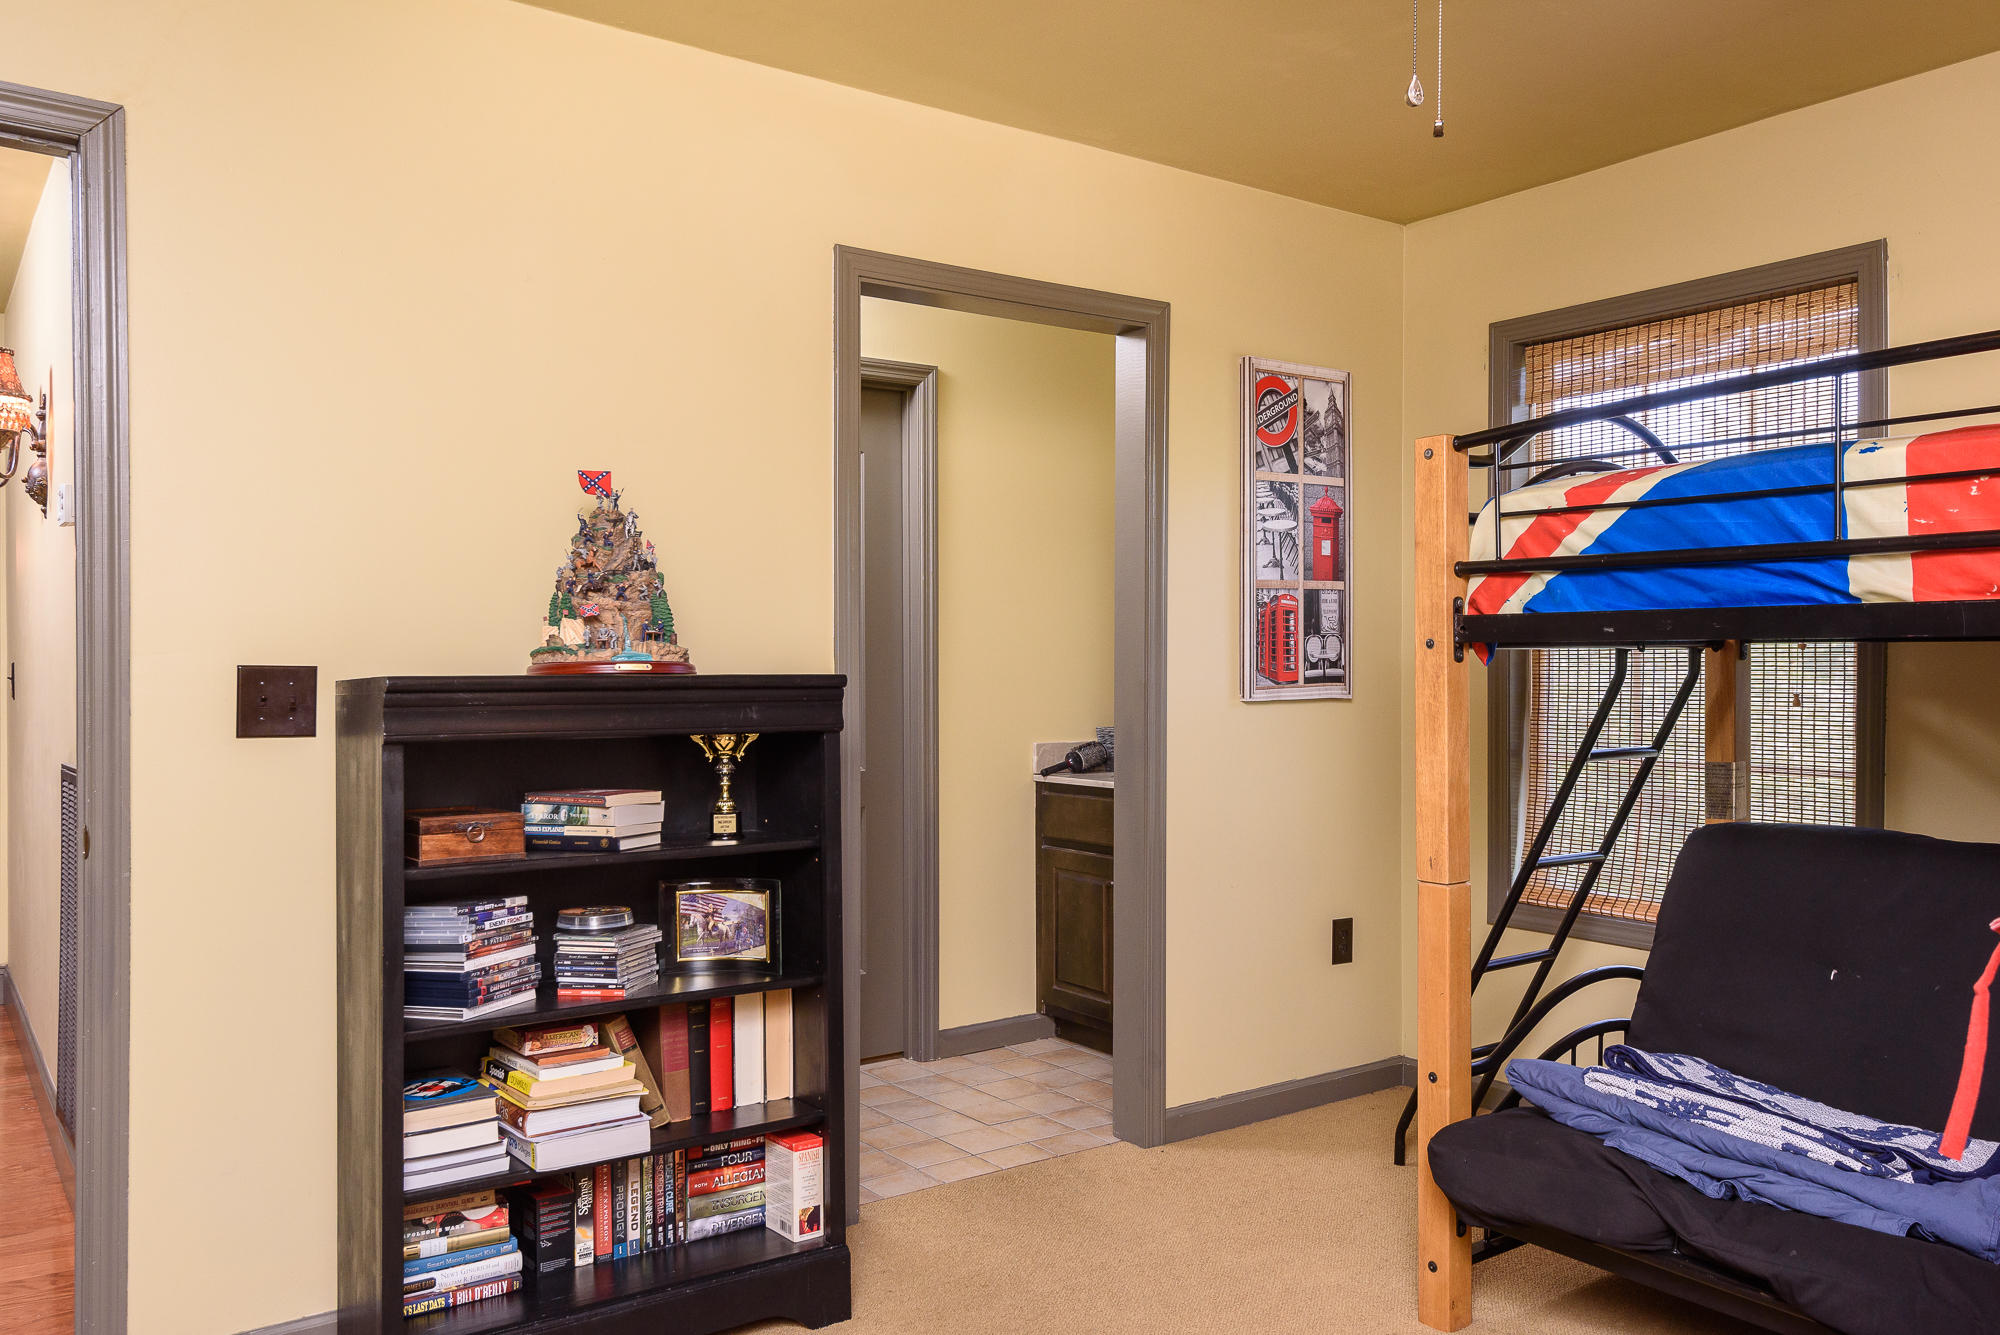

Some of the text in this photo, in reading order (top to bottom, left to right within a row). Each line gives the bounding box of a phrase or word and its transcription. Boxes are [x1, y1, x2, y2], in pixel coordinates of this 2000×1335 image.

[489, 919, 506, 928] ENEMY
[507, 915, 522, 924] FRONT
[489, 1064, 505, 1080] Spanish
[710, 1142, 729, 1152] ONLY
[730, 1138, 752, 1148] THING
[721, 1151, 753, 1167] FOUR
[798, 1149, 820, 1163] SPANISH
[656, 1164, 664, 1195] SCORCH
[675, 1162, 684, 1183] KILL
[578, 1177, 592, 1216] Spanish
[665, 1163, 674, 1215] DEATH CURE
[616, 1185, 624, 1238] PRODIGY
[630, 1180, 638, 1231] LEGEND
[644, 1191, 653, 1227] RUNNER
[656, 1195, 664, 1224] TRIALS
[427, 1260, 445, 1269] Smart
[446, 1256, 465, 1267] Money
[465, 1252, 483, 1261] Smart
[484, 1248, 497, 1256] Kids
[422, 1279, 435, 1289] EAST
[456, 1280, 508, 1306] BILL O'REILLY
[413, 1300, 429, 1315] LAST
[429, 1297, 446, 1311] DAYS
